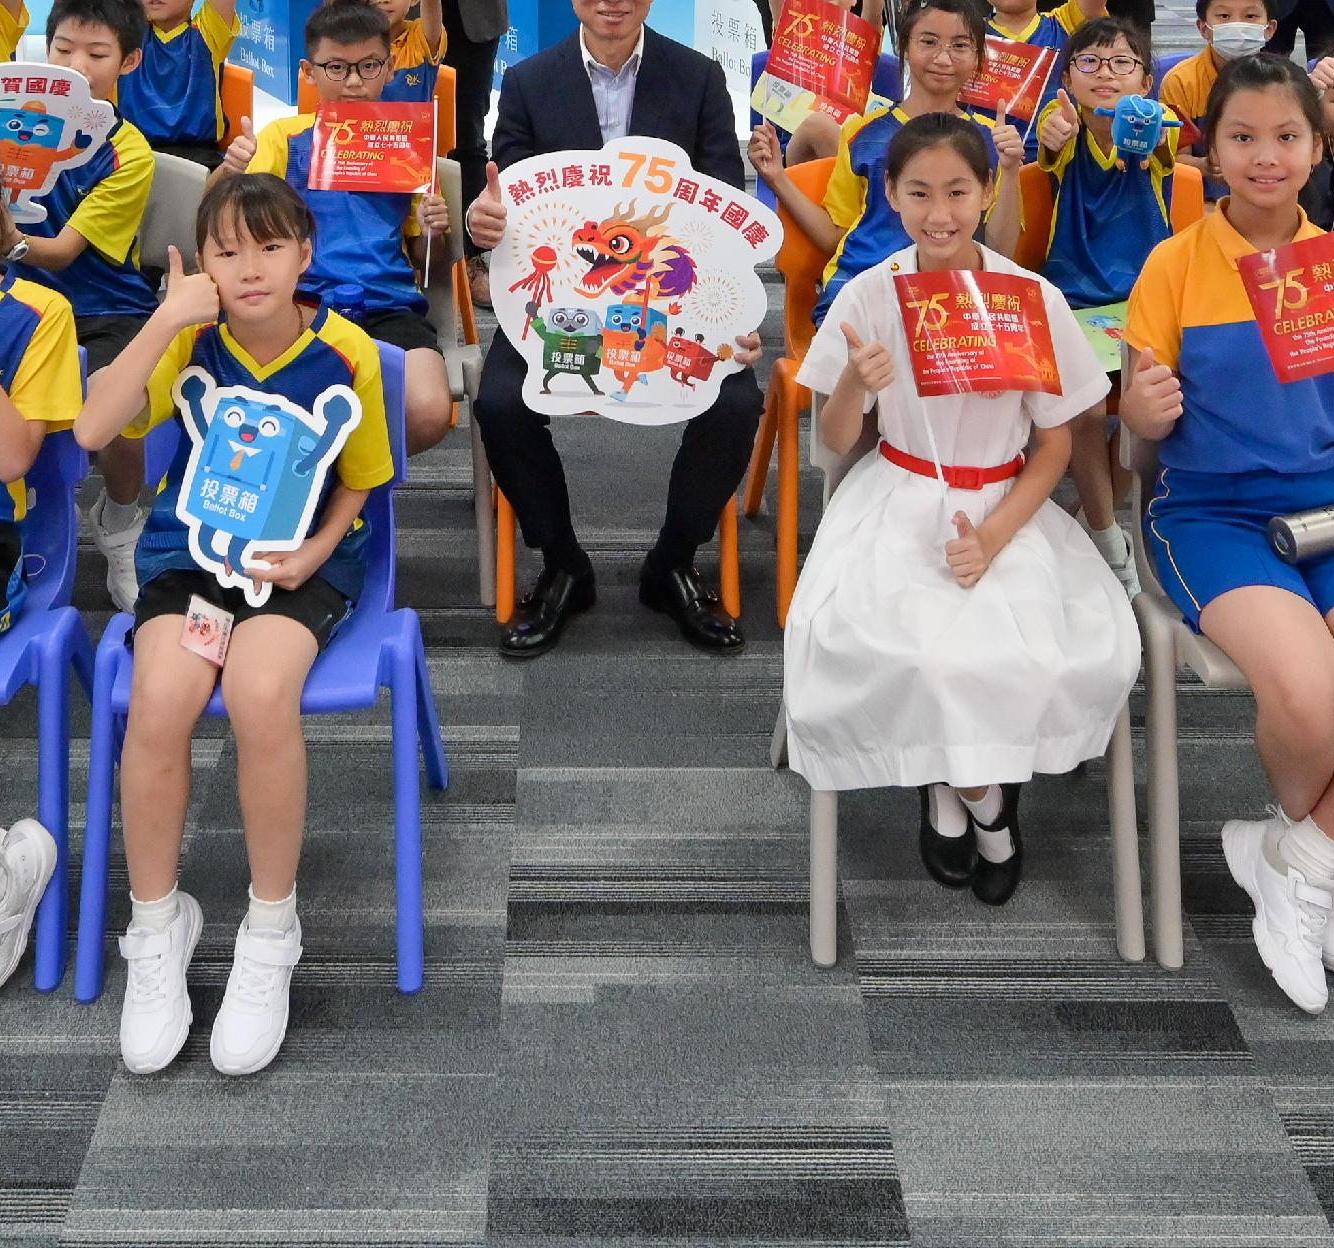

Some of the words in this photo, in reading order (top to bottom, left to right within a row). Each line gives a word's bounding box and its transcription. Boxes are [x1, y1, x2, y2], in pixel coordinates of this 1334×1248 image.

[711, 10, 757, 51] 投票箱
[740, 59, 751, 77] Bo
[1258, 268, 1308, 320] 75
[913, 335, 997, 352] CELEBRATING
[200, 478, 258, 514] 投票箱
[202, 499, 226, 518] Ballot
[228, 507, 247, 522] Box
